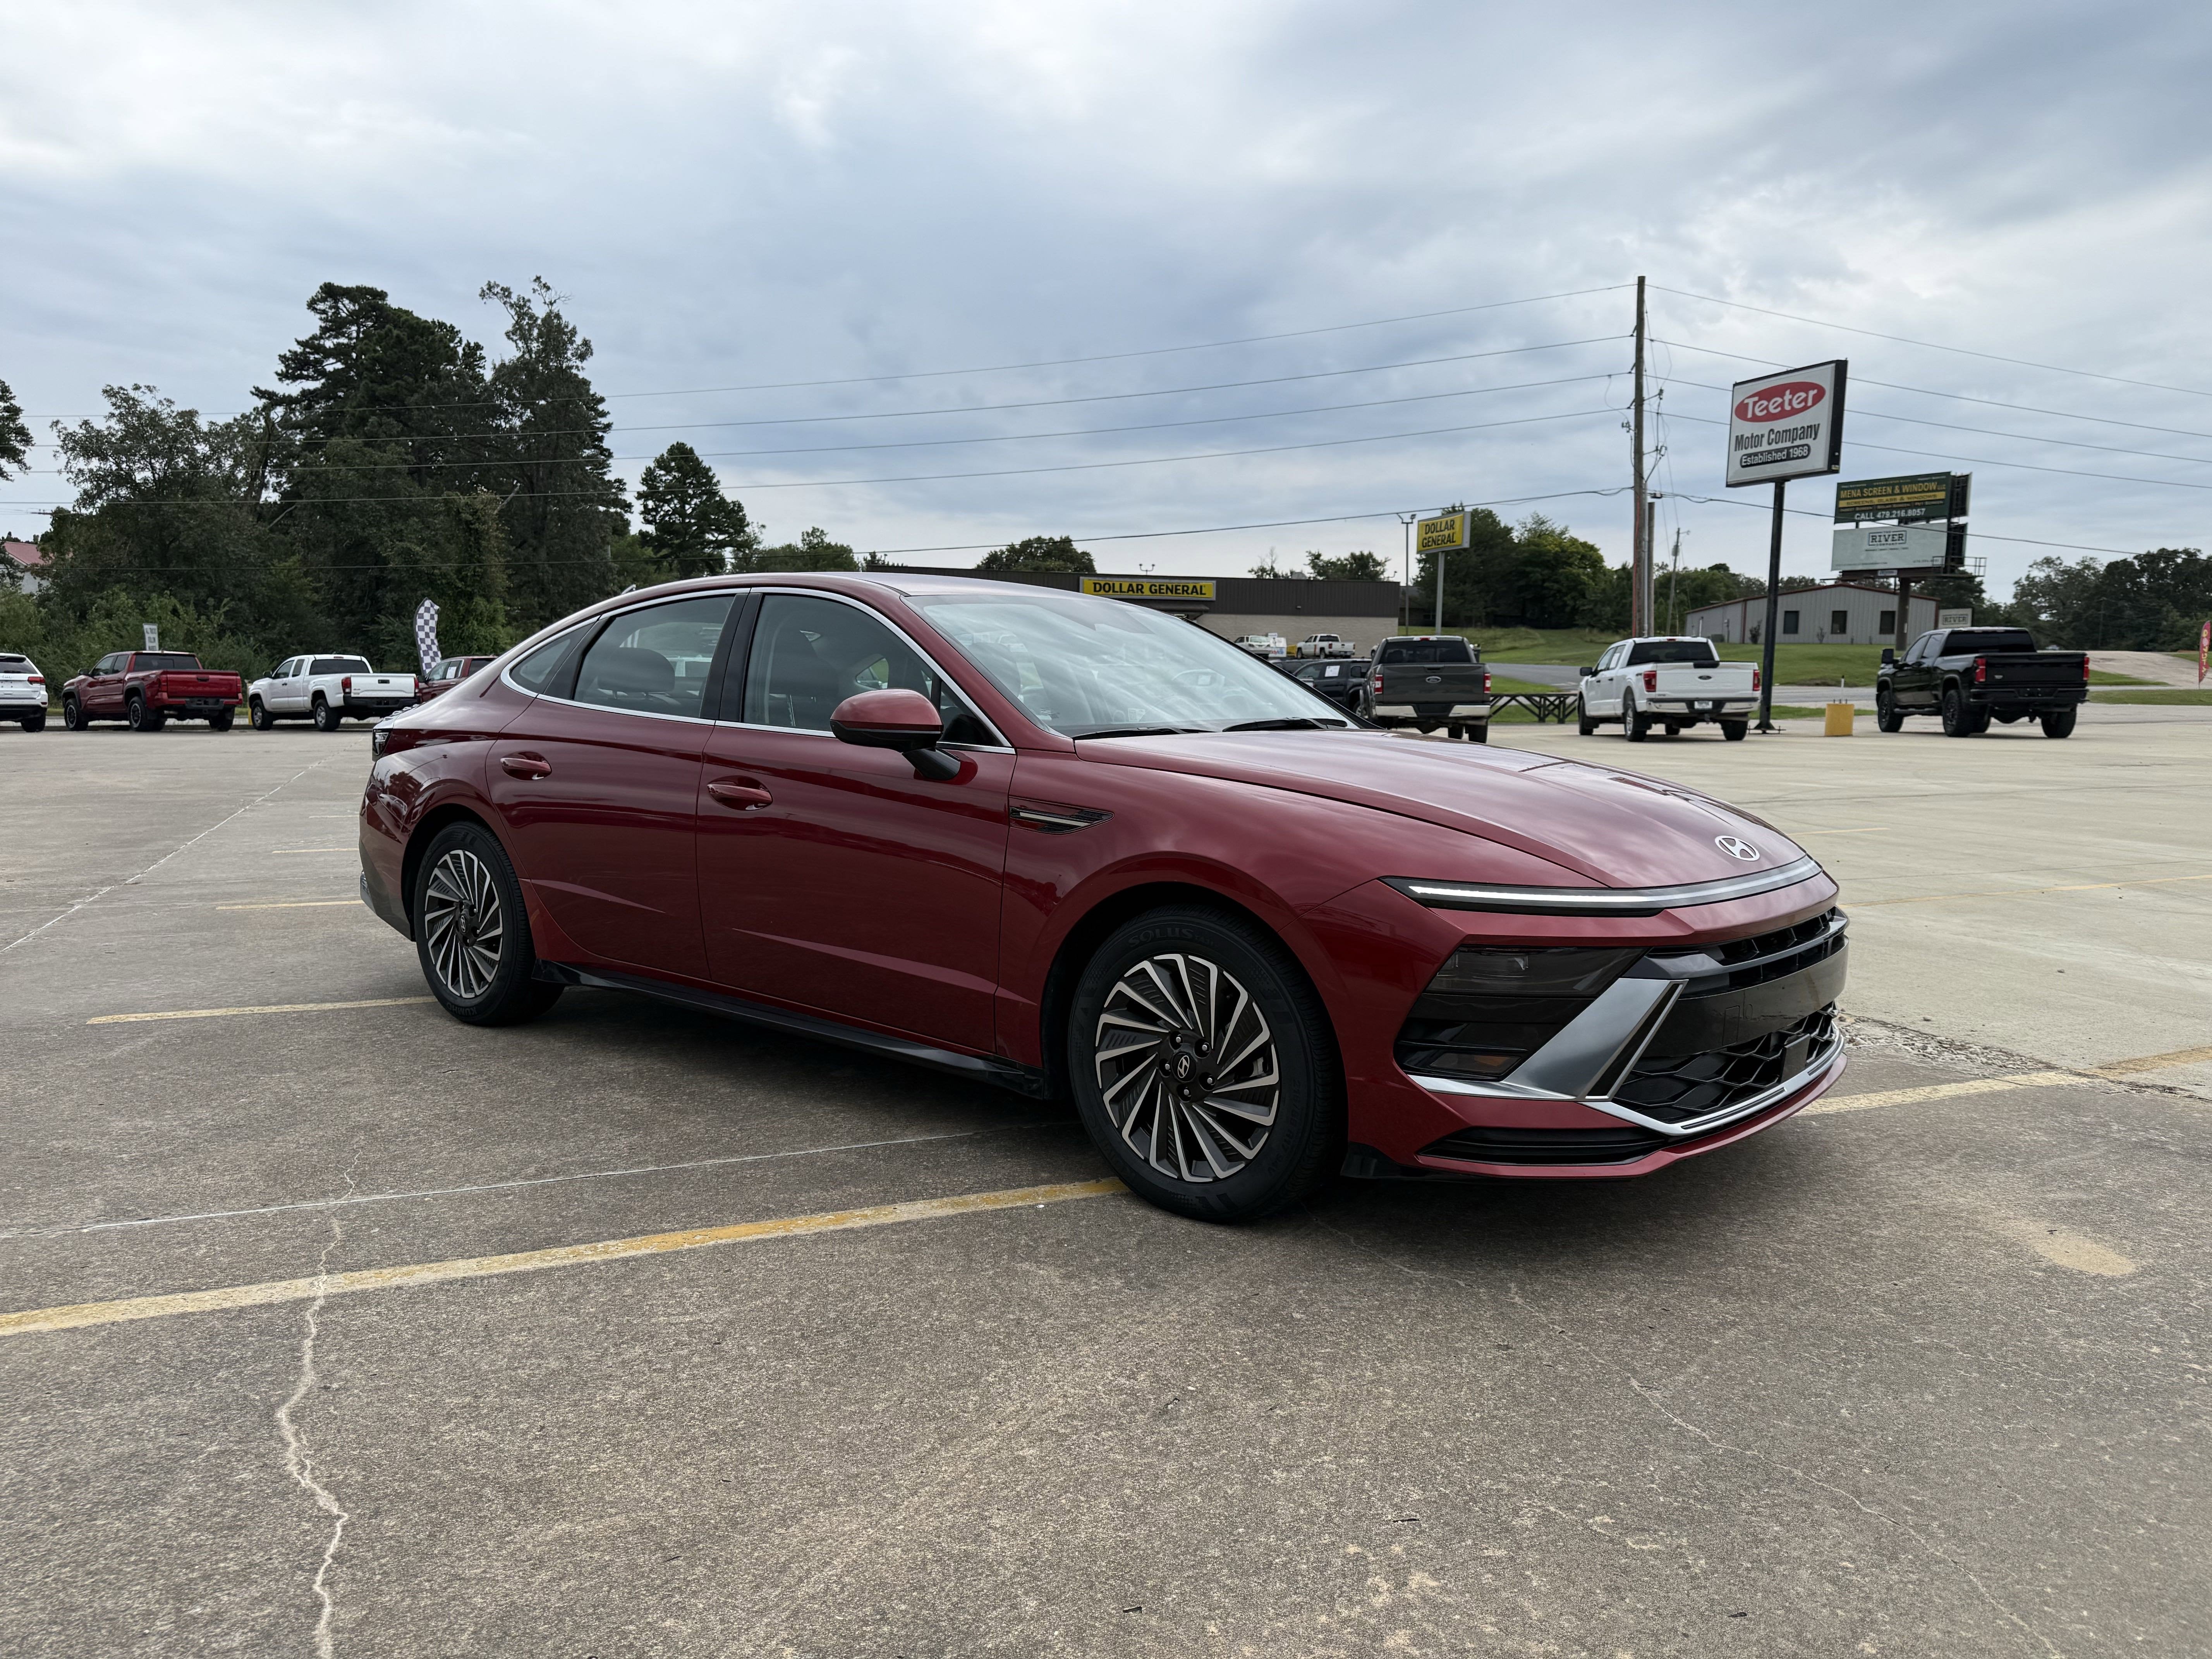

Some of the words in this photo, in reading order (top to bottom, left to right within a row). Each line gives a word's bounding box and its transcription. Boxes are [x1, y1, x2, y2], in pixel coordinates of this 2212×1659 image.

[1744, 389, 1818, 418] Teeter
[1735, 433, 1765, 452] Motor
[1767, 423, 1820, 446] Company
[1743, 449, 1787, 465] Established
[1789, 446, 1808, 458] 1968
[1841, 489, 1862, 498] MENA
[1863, 486, 1892, 497] SCREEN
[1902, 482, 1937, 493] WINDOW
[1855, 512, 1875, 520] CALL
[1425, 519, 1455, 535] DOLLAR
[1422, 532, 1456, 548] GENERAL
[1871, 534, 1904, 543] RIVER
[1093, 582, 1144, 594] DOLLAR
[1149, 583, 1206, 595] GENERAL
[1128, 927, 1194, 948] SOLUS
[447, 1001, 477, 1017] KUMHO
